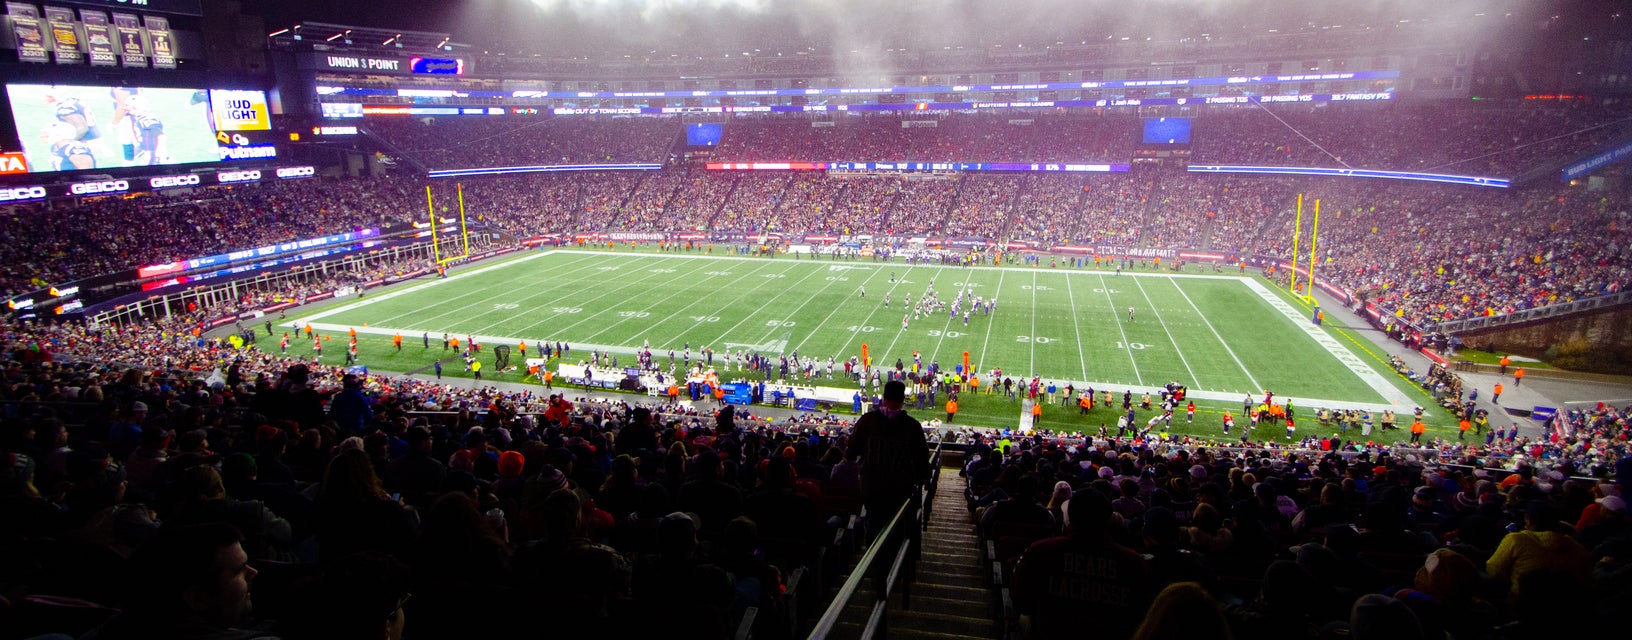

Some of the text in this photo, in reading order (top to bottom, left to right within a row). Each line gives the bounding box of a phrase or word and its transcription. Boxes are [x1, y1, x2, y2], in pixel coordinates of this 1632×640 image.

[327, 56, 399, 70] UNION POINT
[224, 99, 251, 109] BUD
[222, 110, 257, 119] LIGHT
[219, 145, 277, 159] Putnam
[217, 170, 262, 182] GEICO
[276, 166, 315, 178] GEICO
[150, 174, 200, 188] GEICO
[70, 180, 129, 195] GEICO
[765, 320, 796, 328] 50
[847, 325, 875, 333] 40
[927, 329, 960, 338] 30
[1016, 335, 1052, 344] 20
[1116, 341, 1145, 350] 10
[1063, 551, 1119, 580] BEARS
